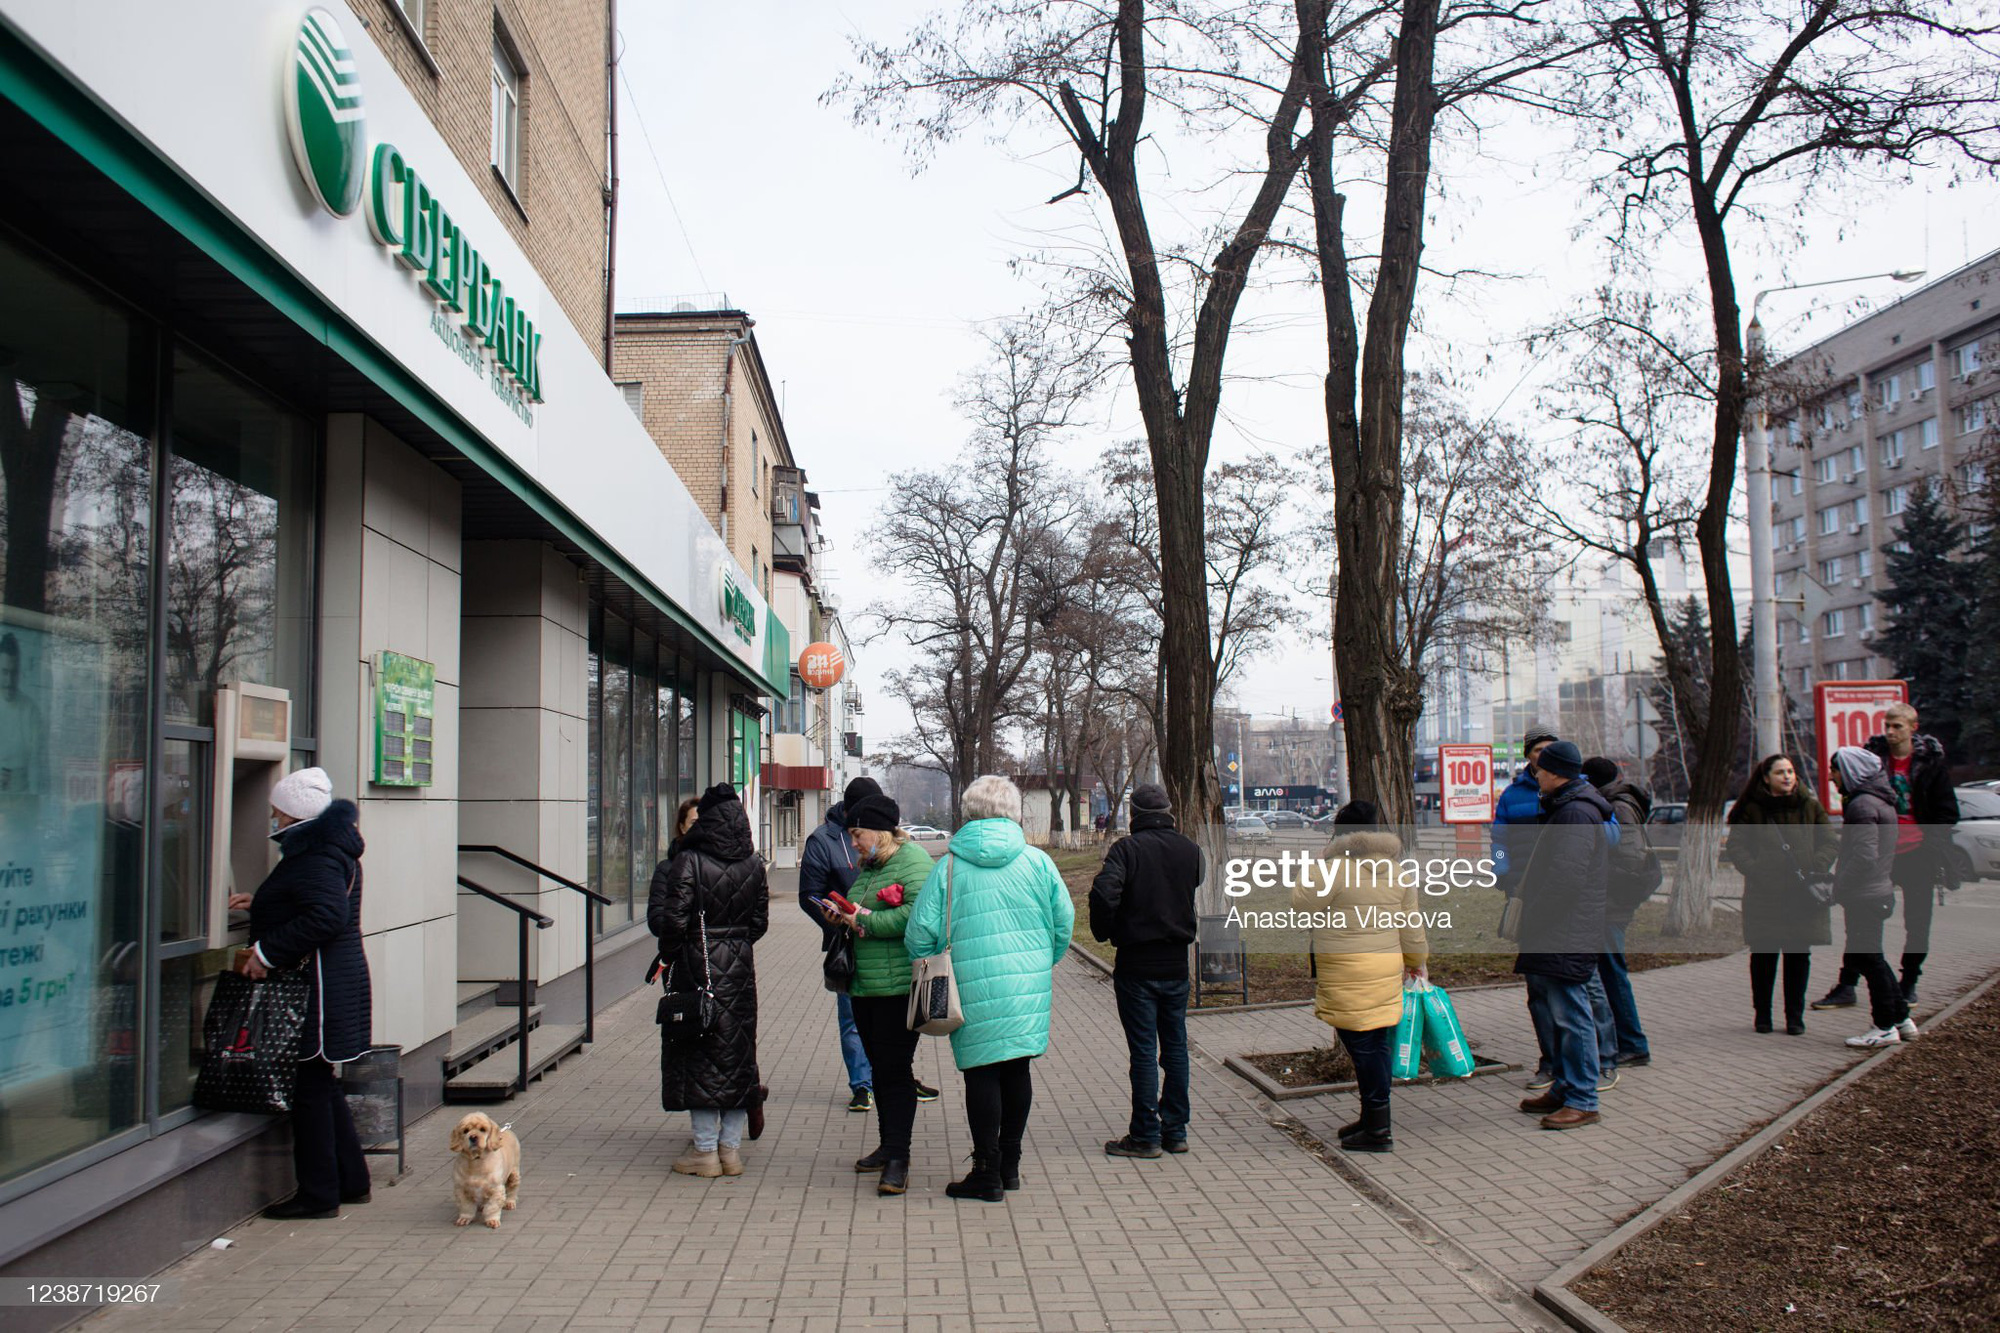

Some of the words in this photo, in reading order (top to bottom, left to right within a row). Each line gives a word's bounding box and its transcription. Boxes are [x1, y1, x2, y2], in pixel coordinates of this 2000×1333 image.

[365, 142, 545, 404] СБЕРБАНК
[430, 311, 485, 380] АКЦІОНЕРНЕ
[1448, 760, 1486, 785] 100
[13, 900, 87, 935] рахунки
[18, 976, 32, 1004] 5
